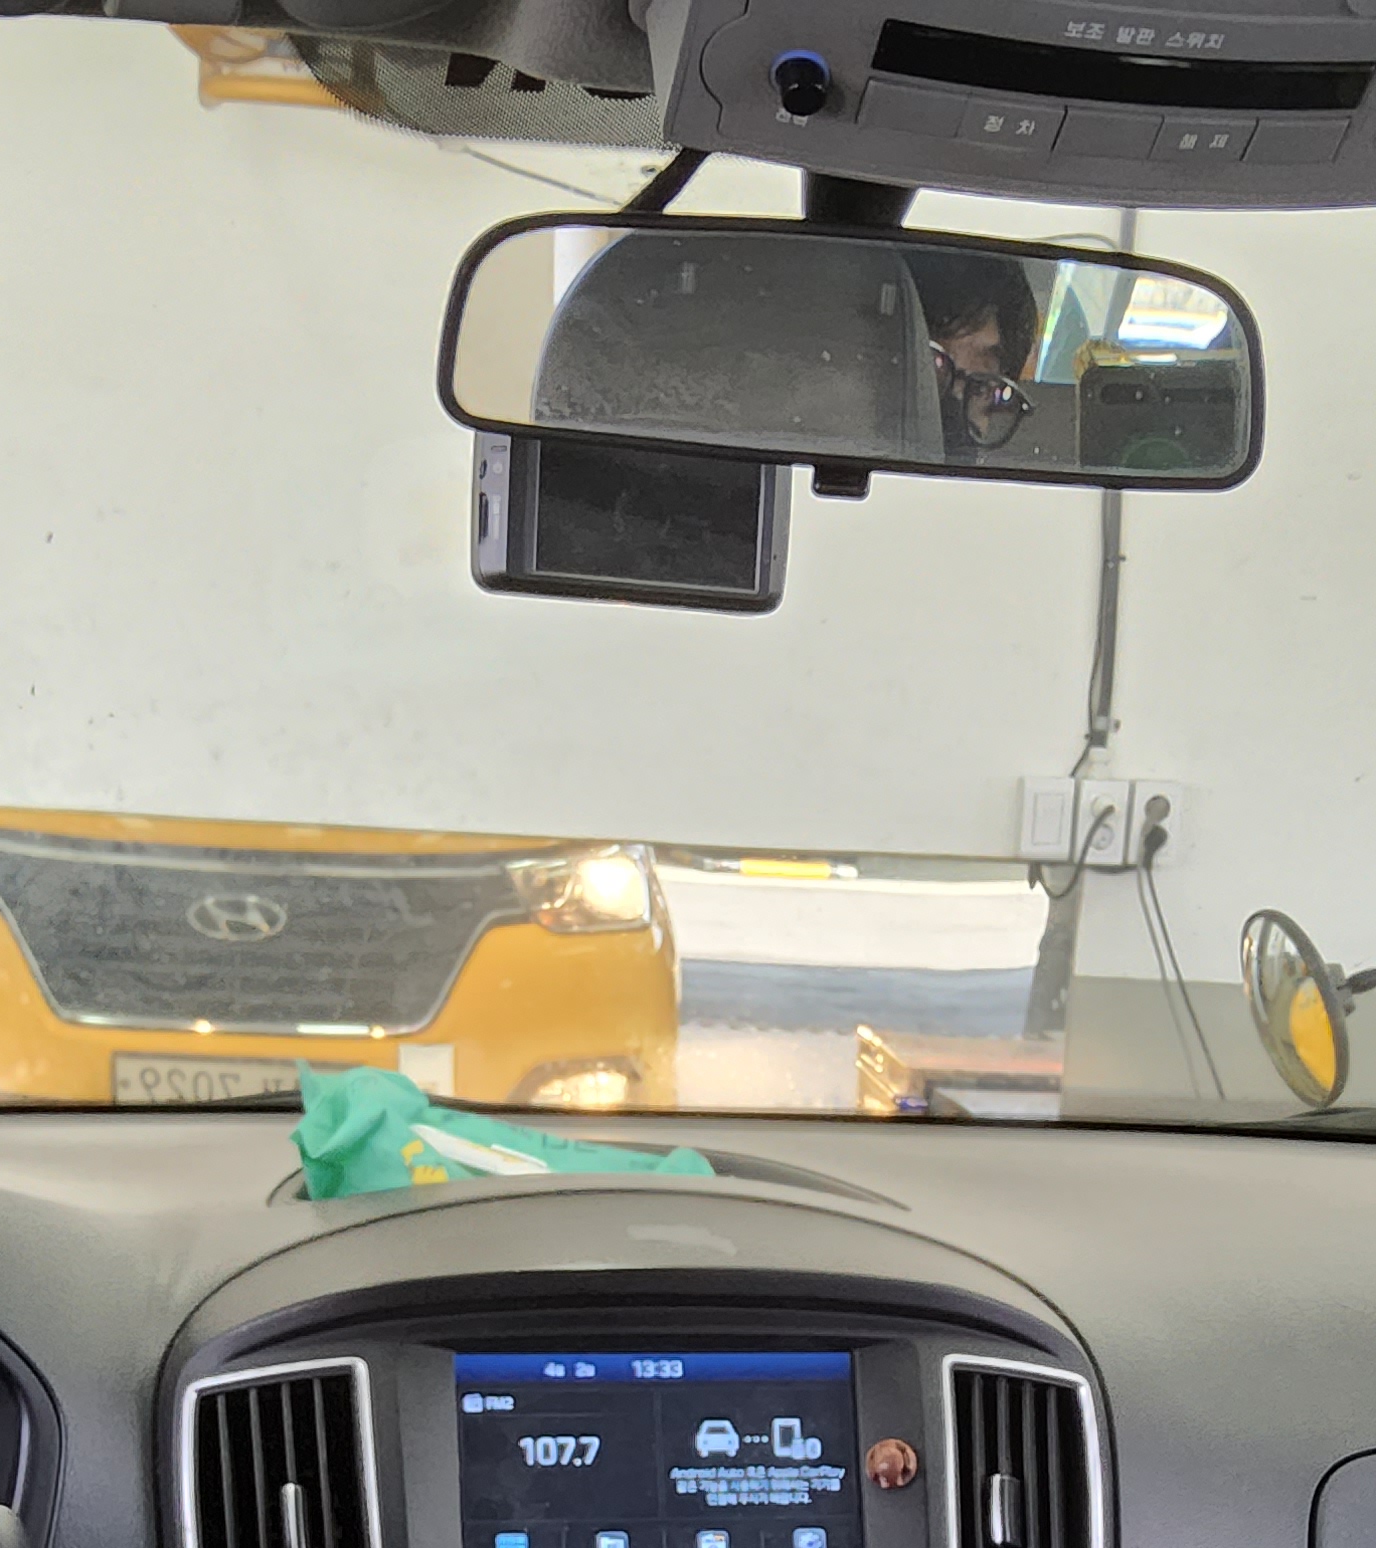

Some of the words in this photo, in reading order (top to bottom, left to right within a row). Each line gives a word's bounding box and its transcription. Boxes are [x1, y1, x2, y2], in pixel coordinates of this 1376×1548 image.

[1064, 20, 1105, 40] 보조
[1116, 25, 1156, 46] 발판
[1165, 31, 1225, 49] 스위치
[631, 1359, 684, 1379] 13:33
[518, 1434, 601, 1467] 107.7
